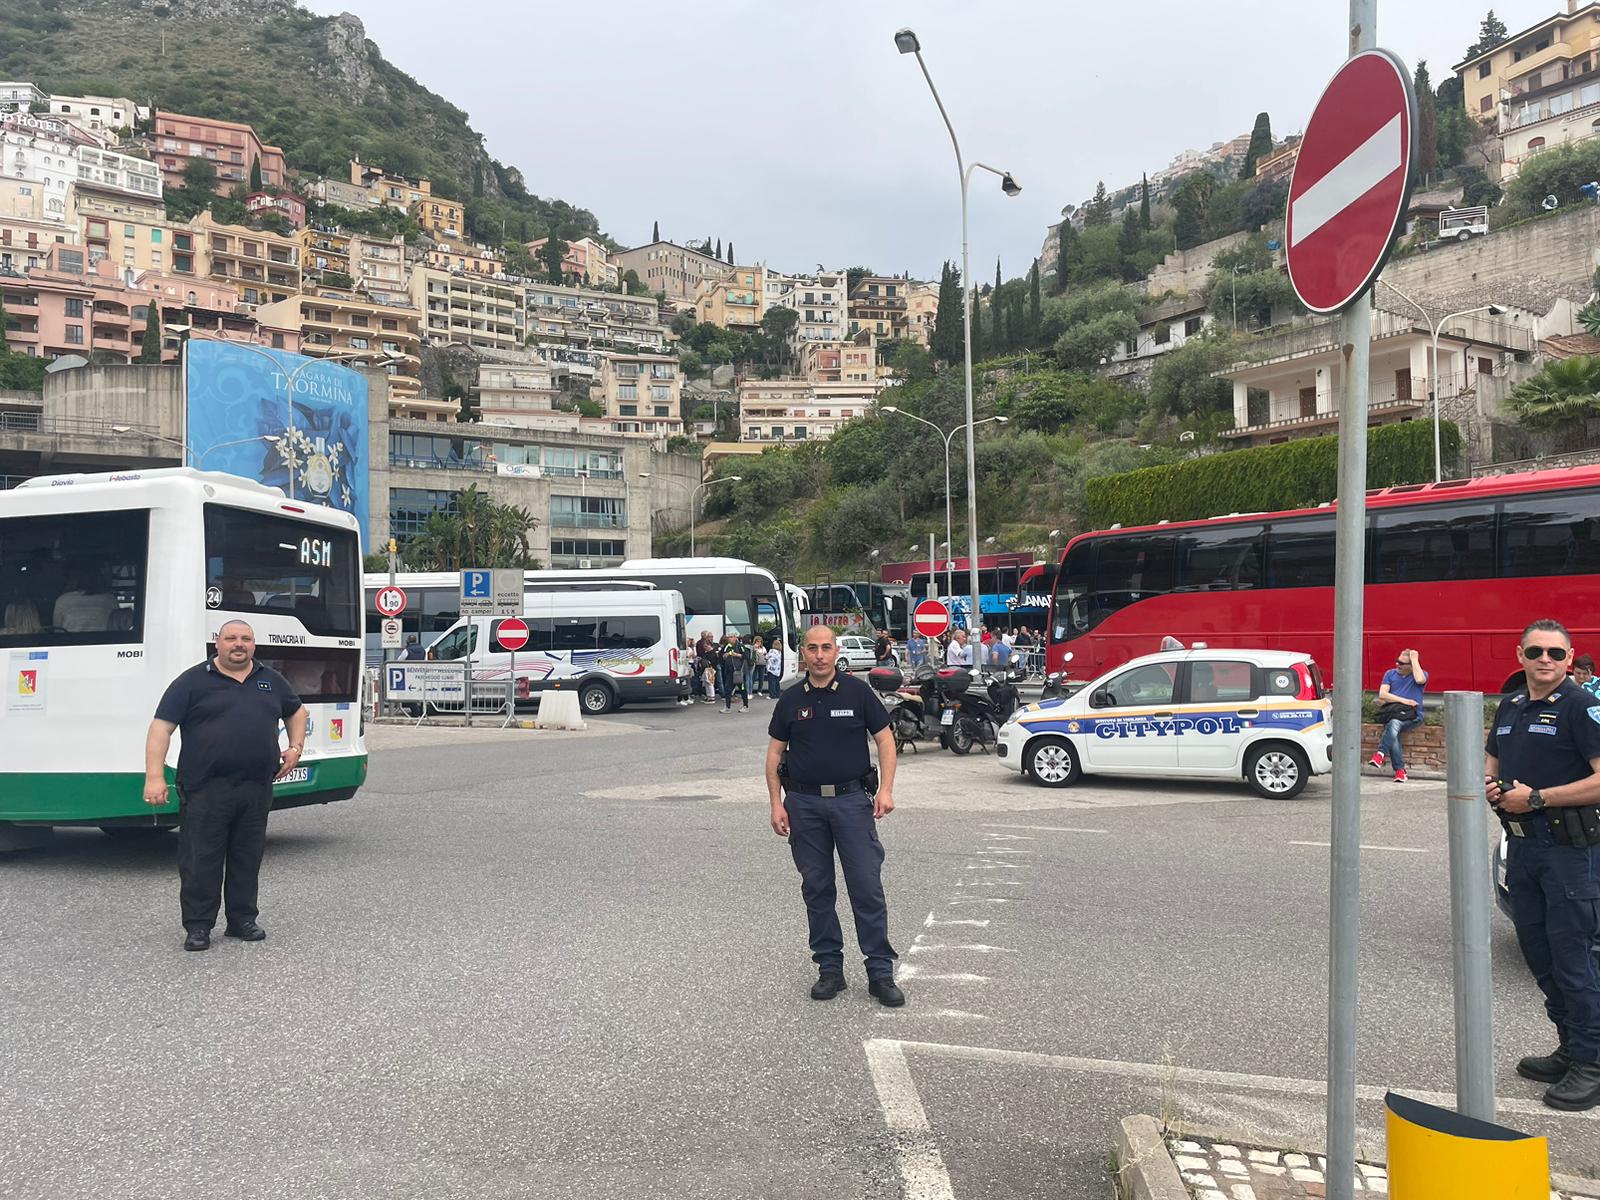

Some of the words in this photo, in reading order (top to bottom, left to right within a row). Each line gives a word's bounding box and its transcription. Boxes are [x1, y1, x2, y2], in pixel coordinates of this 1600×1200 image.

[17, 114, 60, 132] HOTEL
[295, 369, 331, 381] AGARA
[270, 371, 352, 405] TAORMINA
[301, 537, 331, 567] ASM
[472, 572, 483, 588] P
[207, 591, 220, 603] 24
[268, 634, 299, 644] TRINACRIA
[117, 650, 143, 658] MOBI
[392, 670, 403, 689] P
[1095, 717, 1241, 739] CITYPOL
